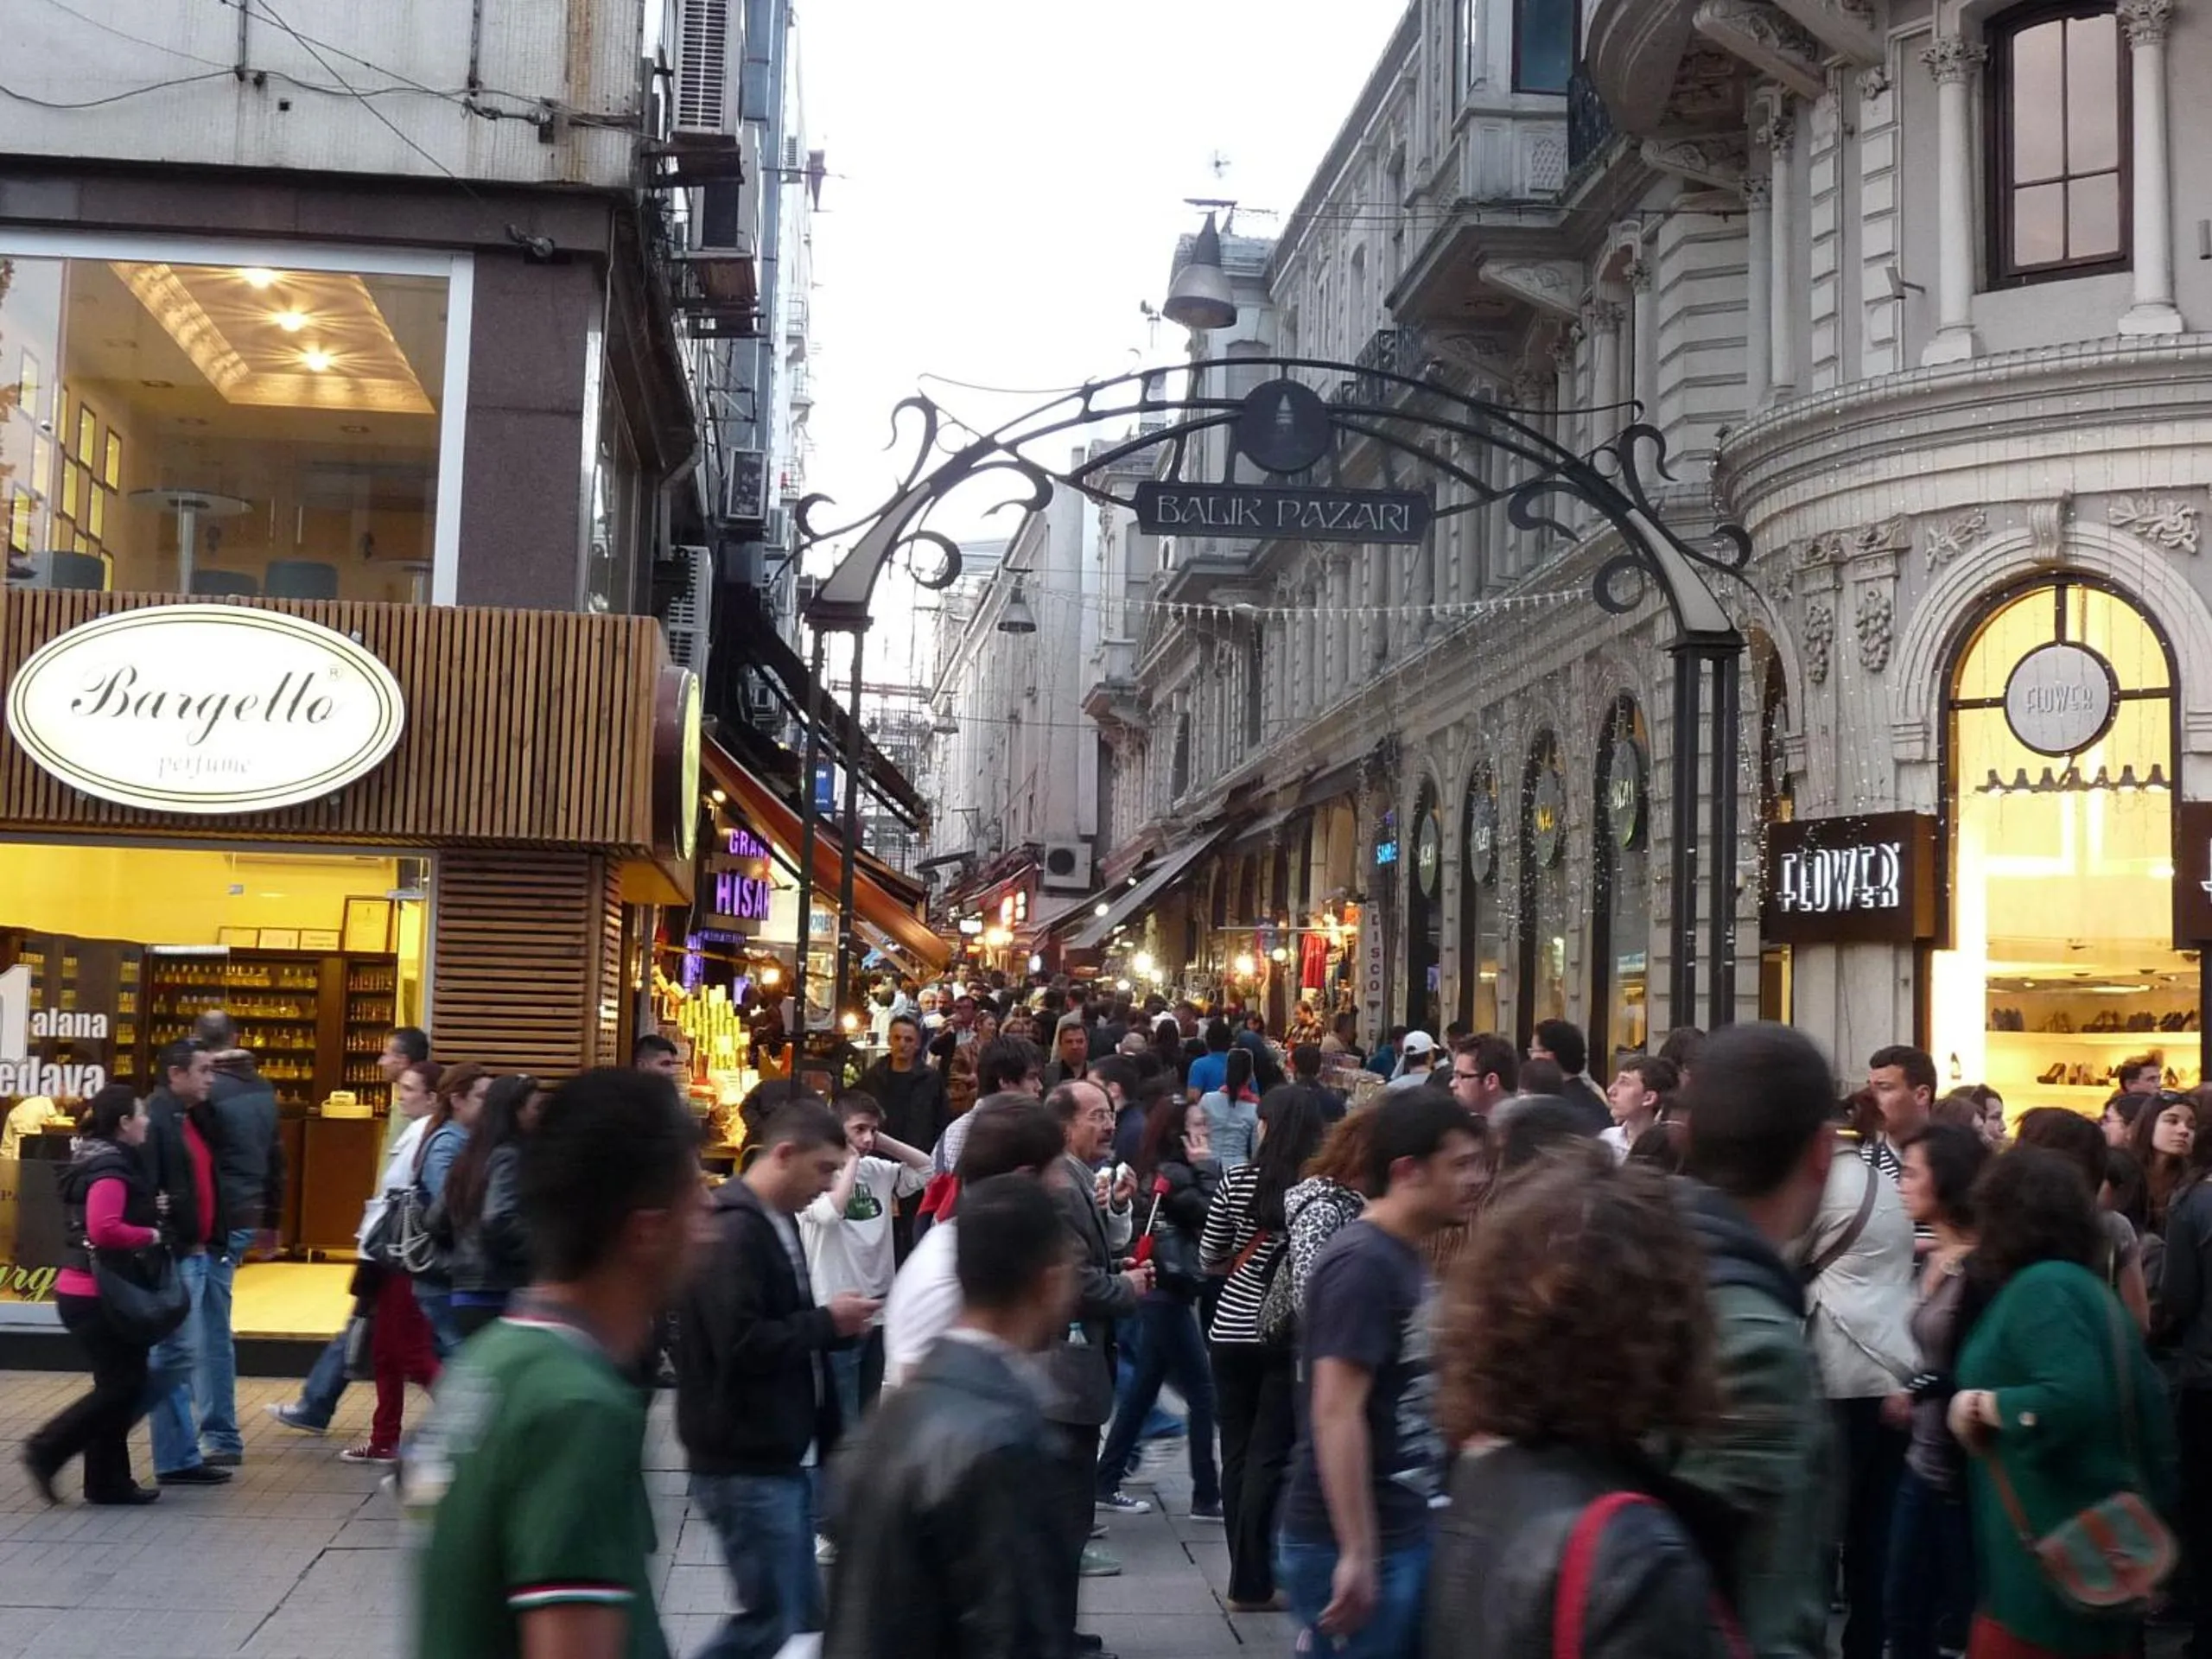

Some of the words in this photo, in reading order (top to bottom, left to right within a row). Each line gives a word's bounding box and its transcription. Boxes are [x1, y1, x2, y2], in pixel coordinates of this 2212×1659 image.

[1156, 494, 1262, 528] BALIK
[1276, 499, 1411, 534] PAZARI
[71, 664, 335, 747] Bargello
[2026, 685, 2094, 714] FLOWER
[158, 755, 252, 779] perfume
[1776, 842, 1900, 912] FLOWER
[32, 1007, 108, 1038] alana
